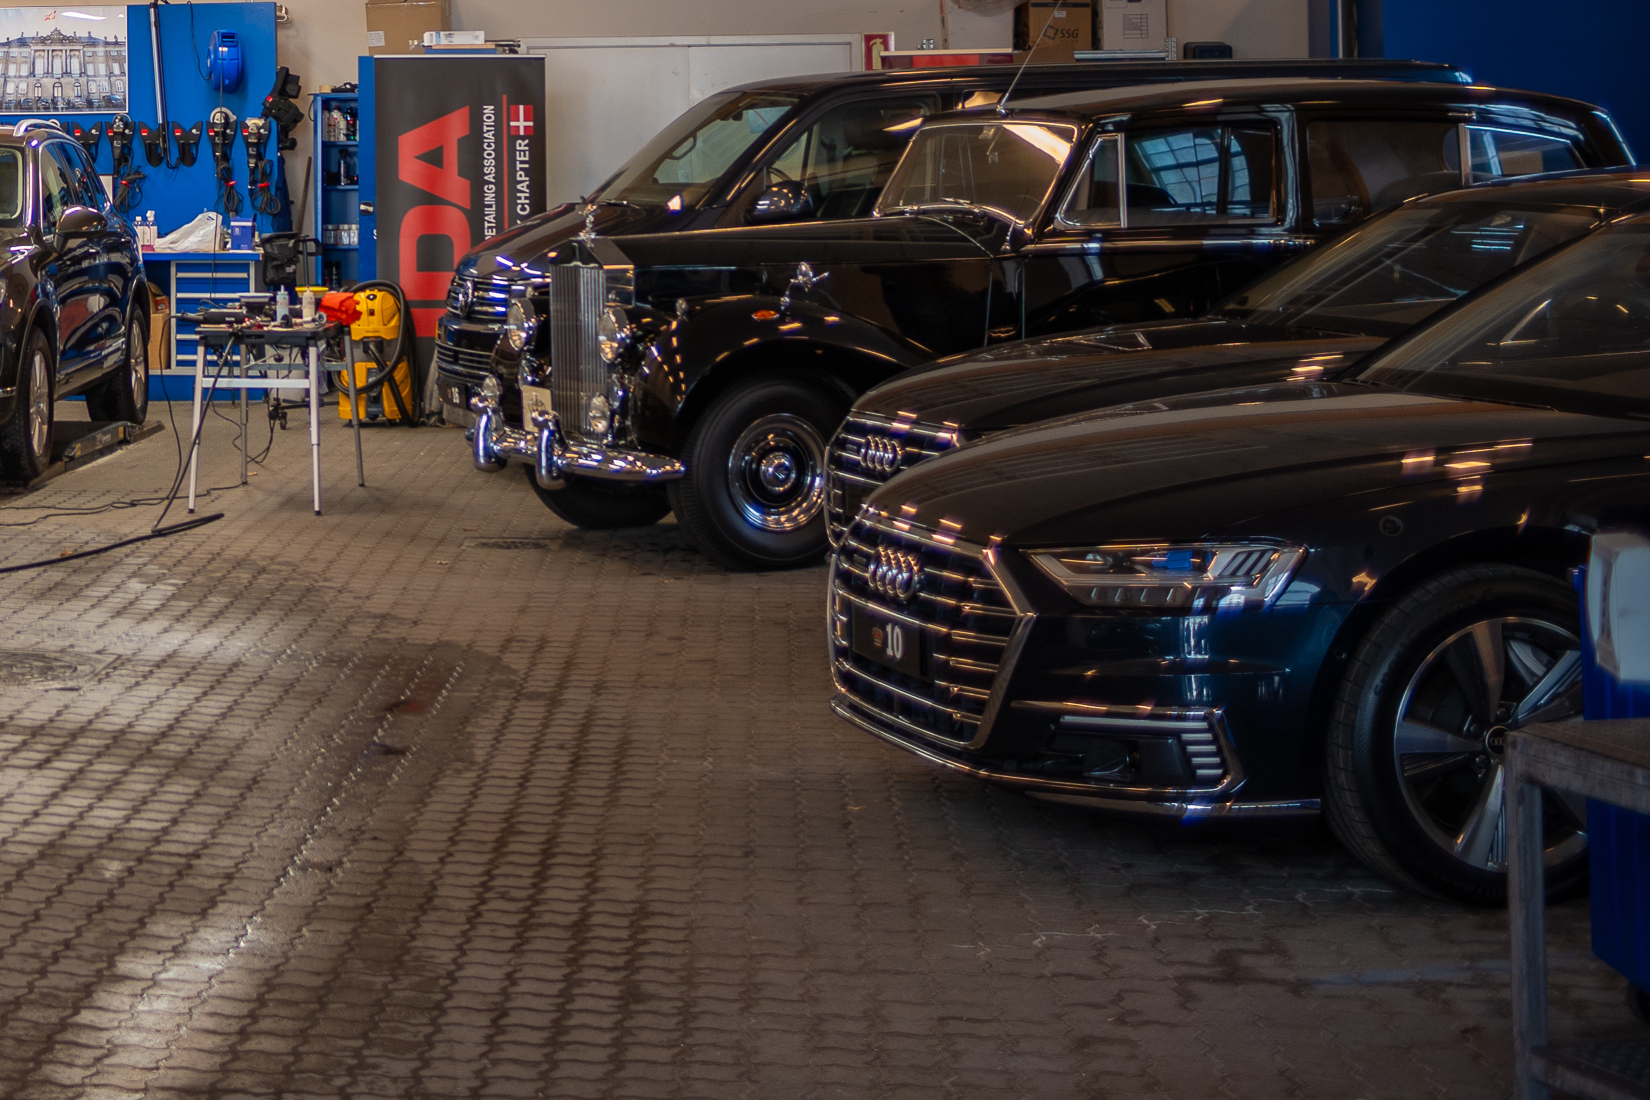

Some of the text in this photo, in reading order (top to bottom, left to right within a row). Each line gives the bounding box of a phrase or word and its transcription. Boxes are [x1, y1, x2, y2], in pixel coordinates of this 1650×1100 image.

[1059, 28, 1079, 39] SSG
[482, 105, 496, 182] ASSOCIATION
[516, 139, 530, 215] CHAPTER
[886, 622, 902, 659] 10
